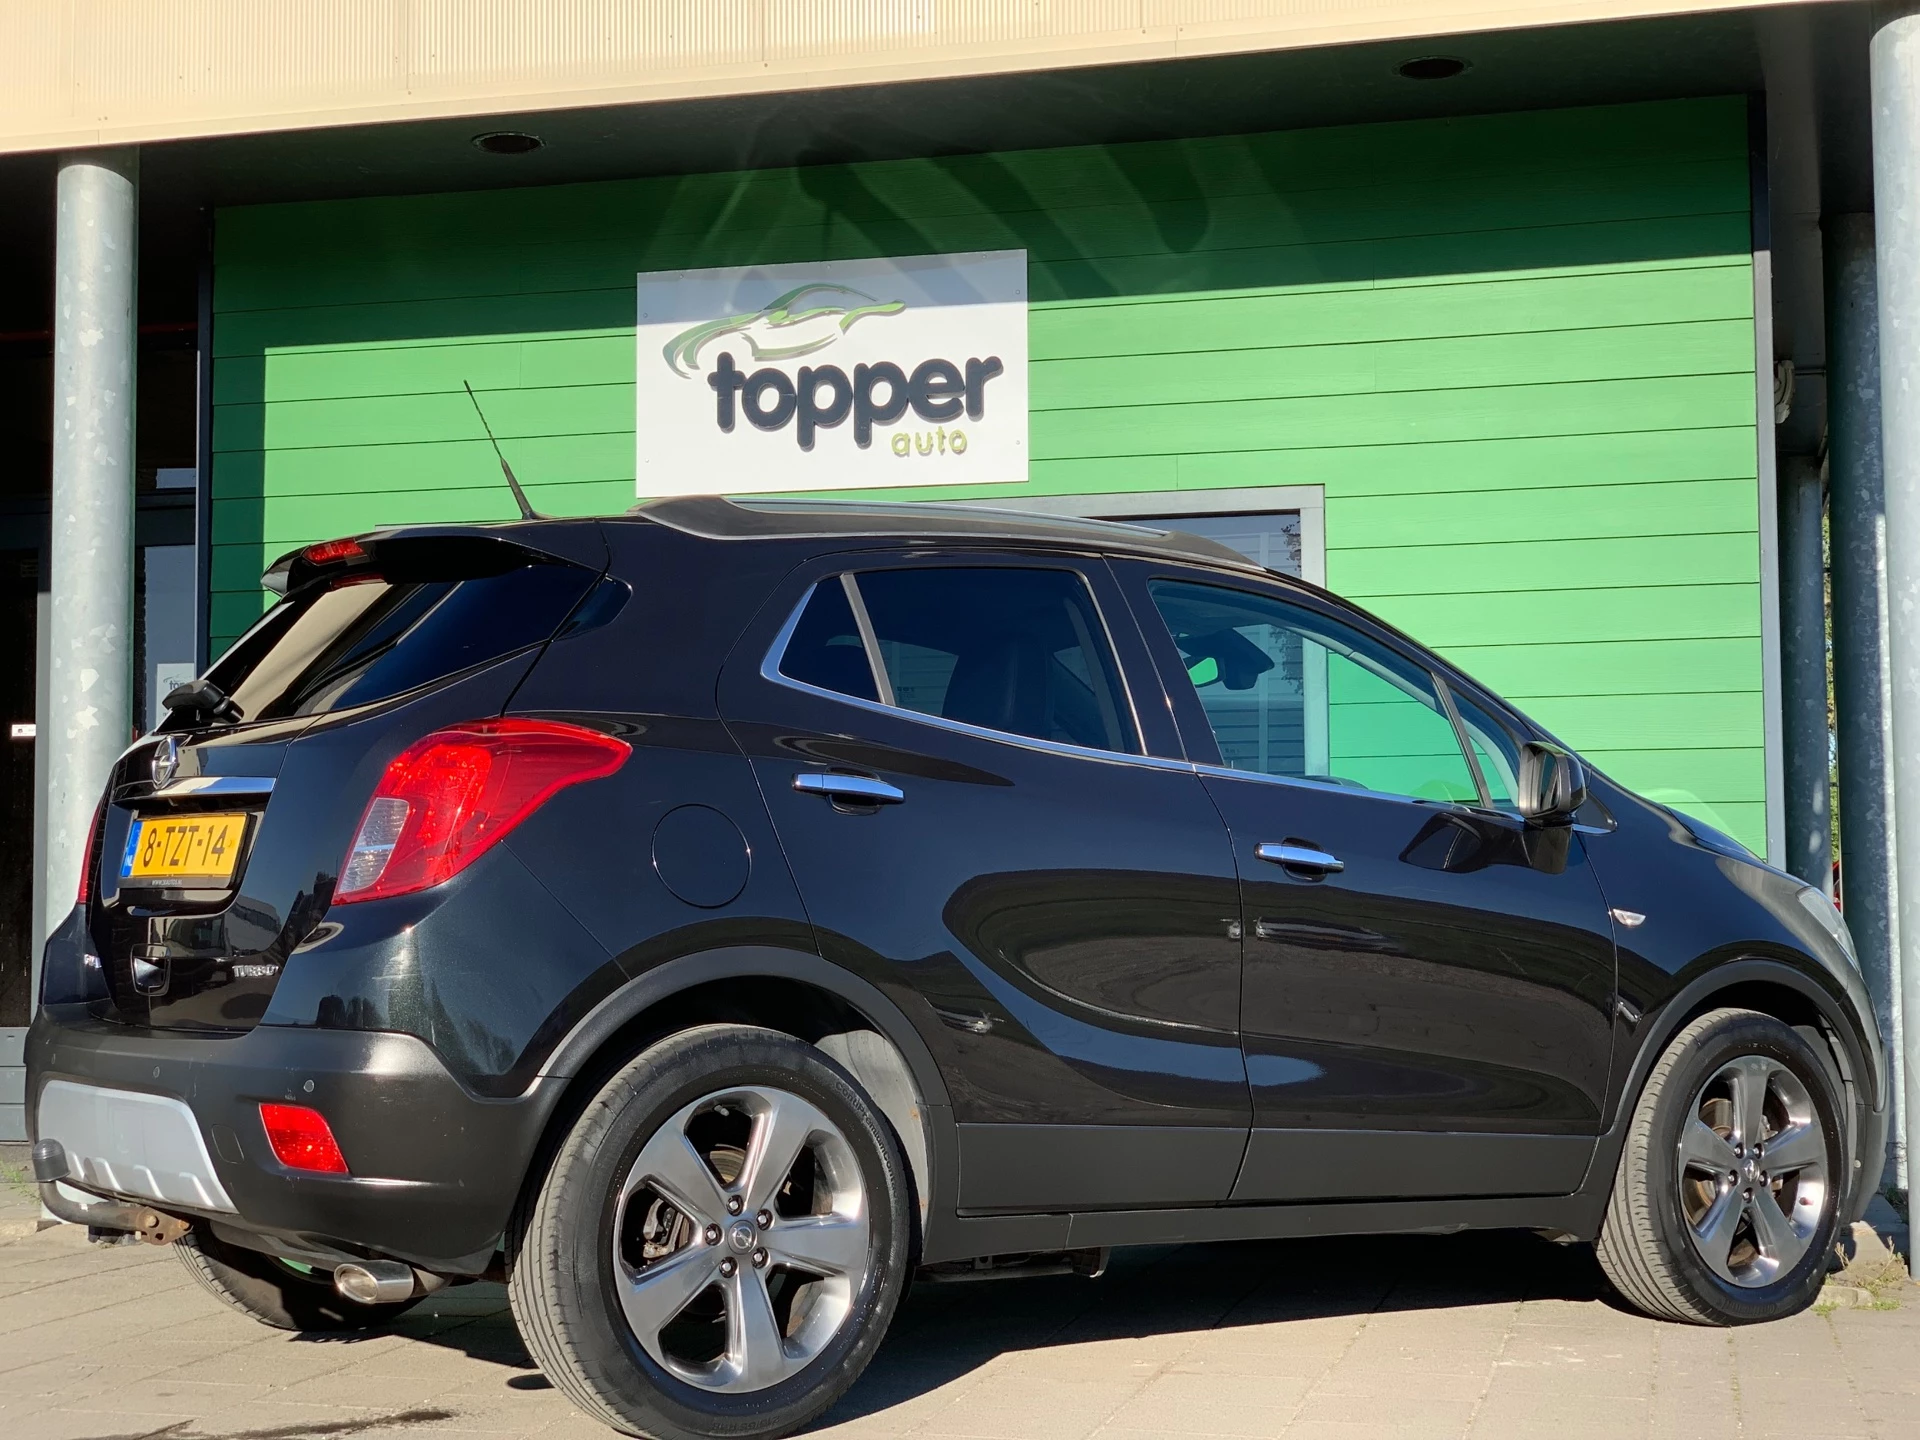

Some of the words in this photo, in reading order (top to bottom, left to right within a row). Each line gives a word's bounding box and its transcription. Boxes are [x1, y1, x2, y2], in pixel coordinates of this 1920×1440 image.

[707, 352, 1003, 452] topper
[891, 425, 967, 456] auto
[143, 824, 229, 868] 8-TZT-14
